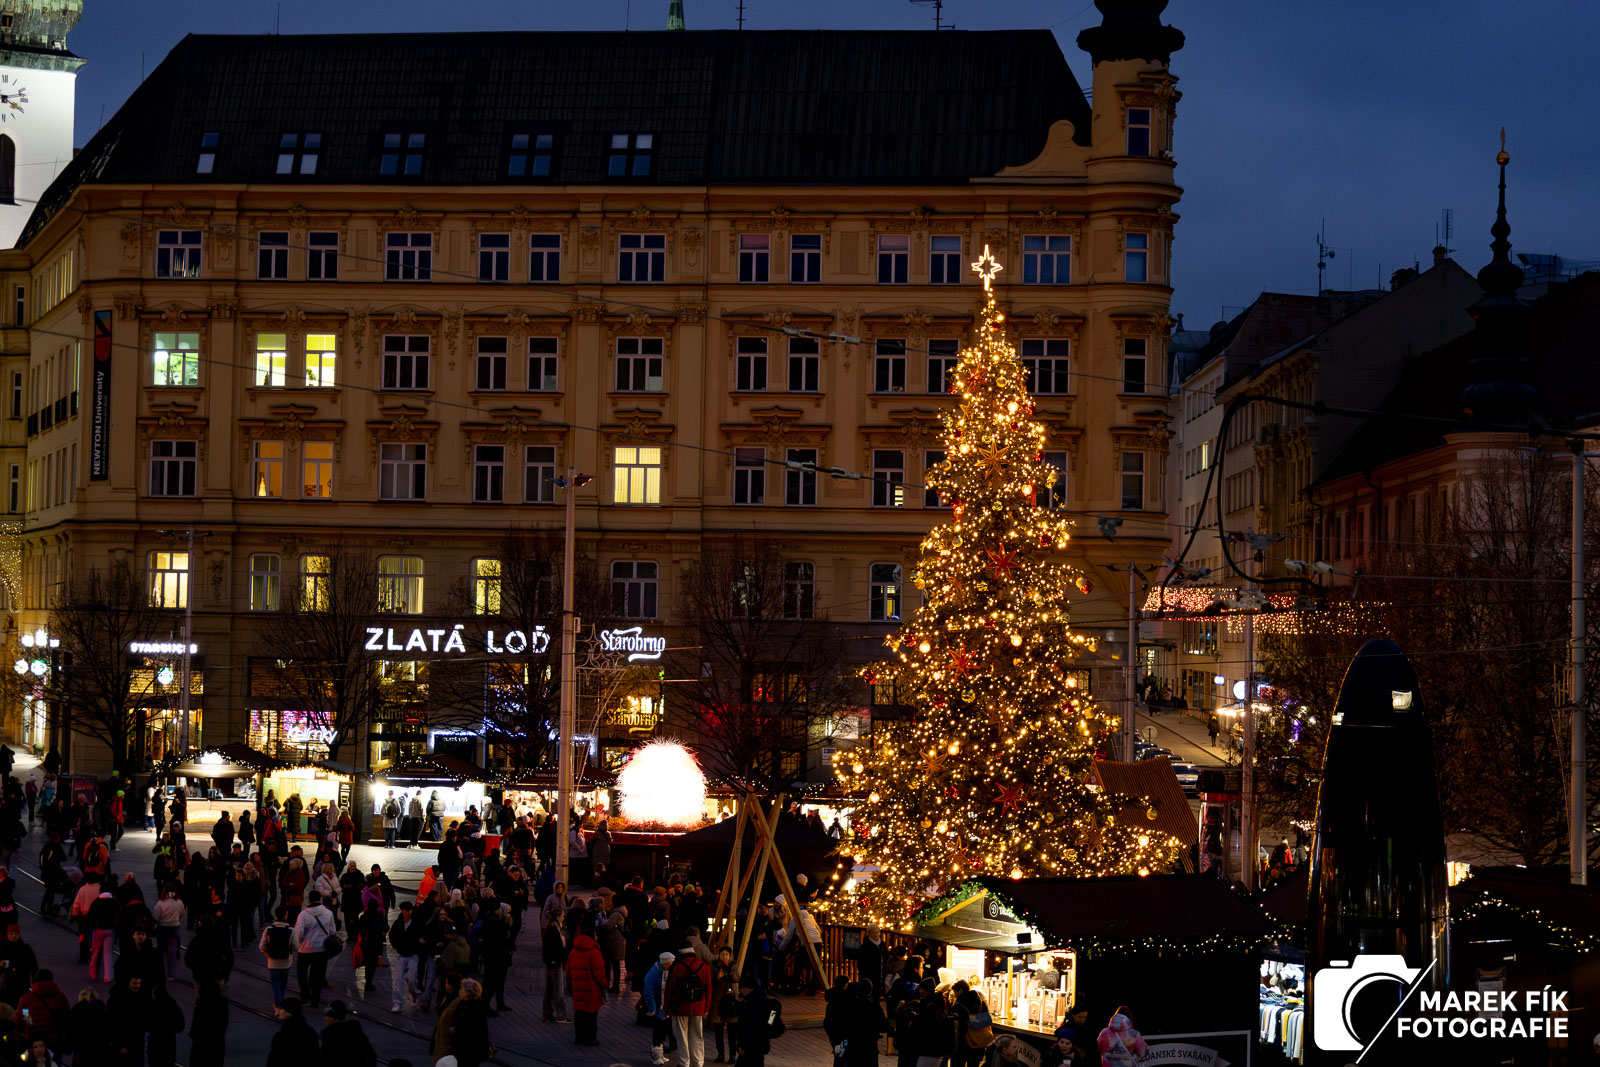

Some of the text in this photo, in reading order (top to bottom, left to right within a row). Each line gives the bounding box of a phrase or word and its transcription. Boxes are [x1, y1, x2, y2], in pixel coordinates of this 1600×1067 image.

[94, 370, 105, 424] University
[93, 425, 102, 475] NEWTON
[130, 642, 198, 654] STARBUCS
[365, 624, 551, 654] ZLATÁ LOĎ
[600, 626, 666, 662] Starobrno
[606, 707, 658, 735] Starobrno
